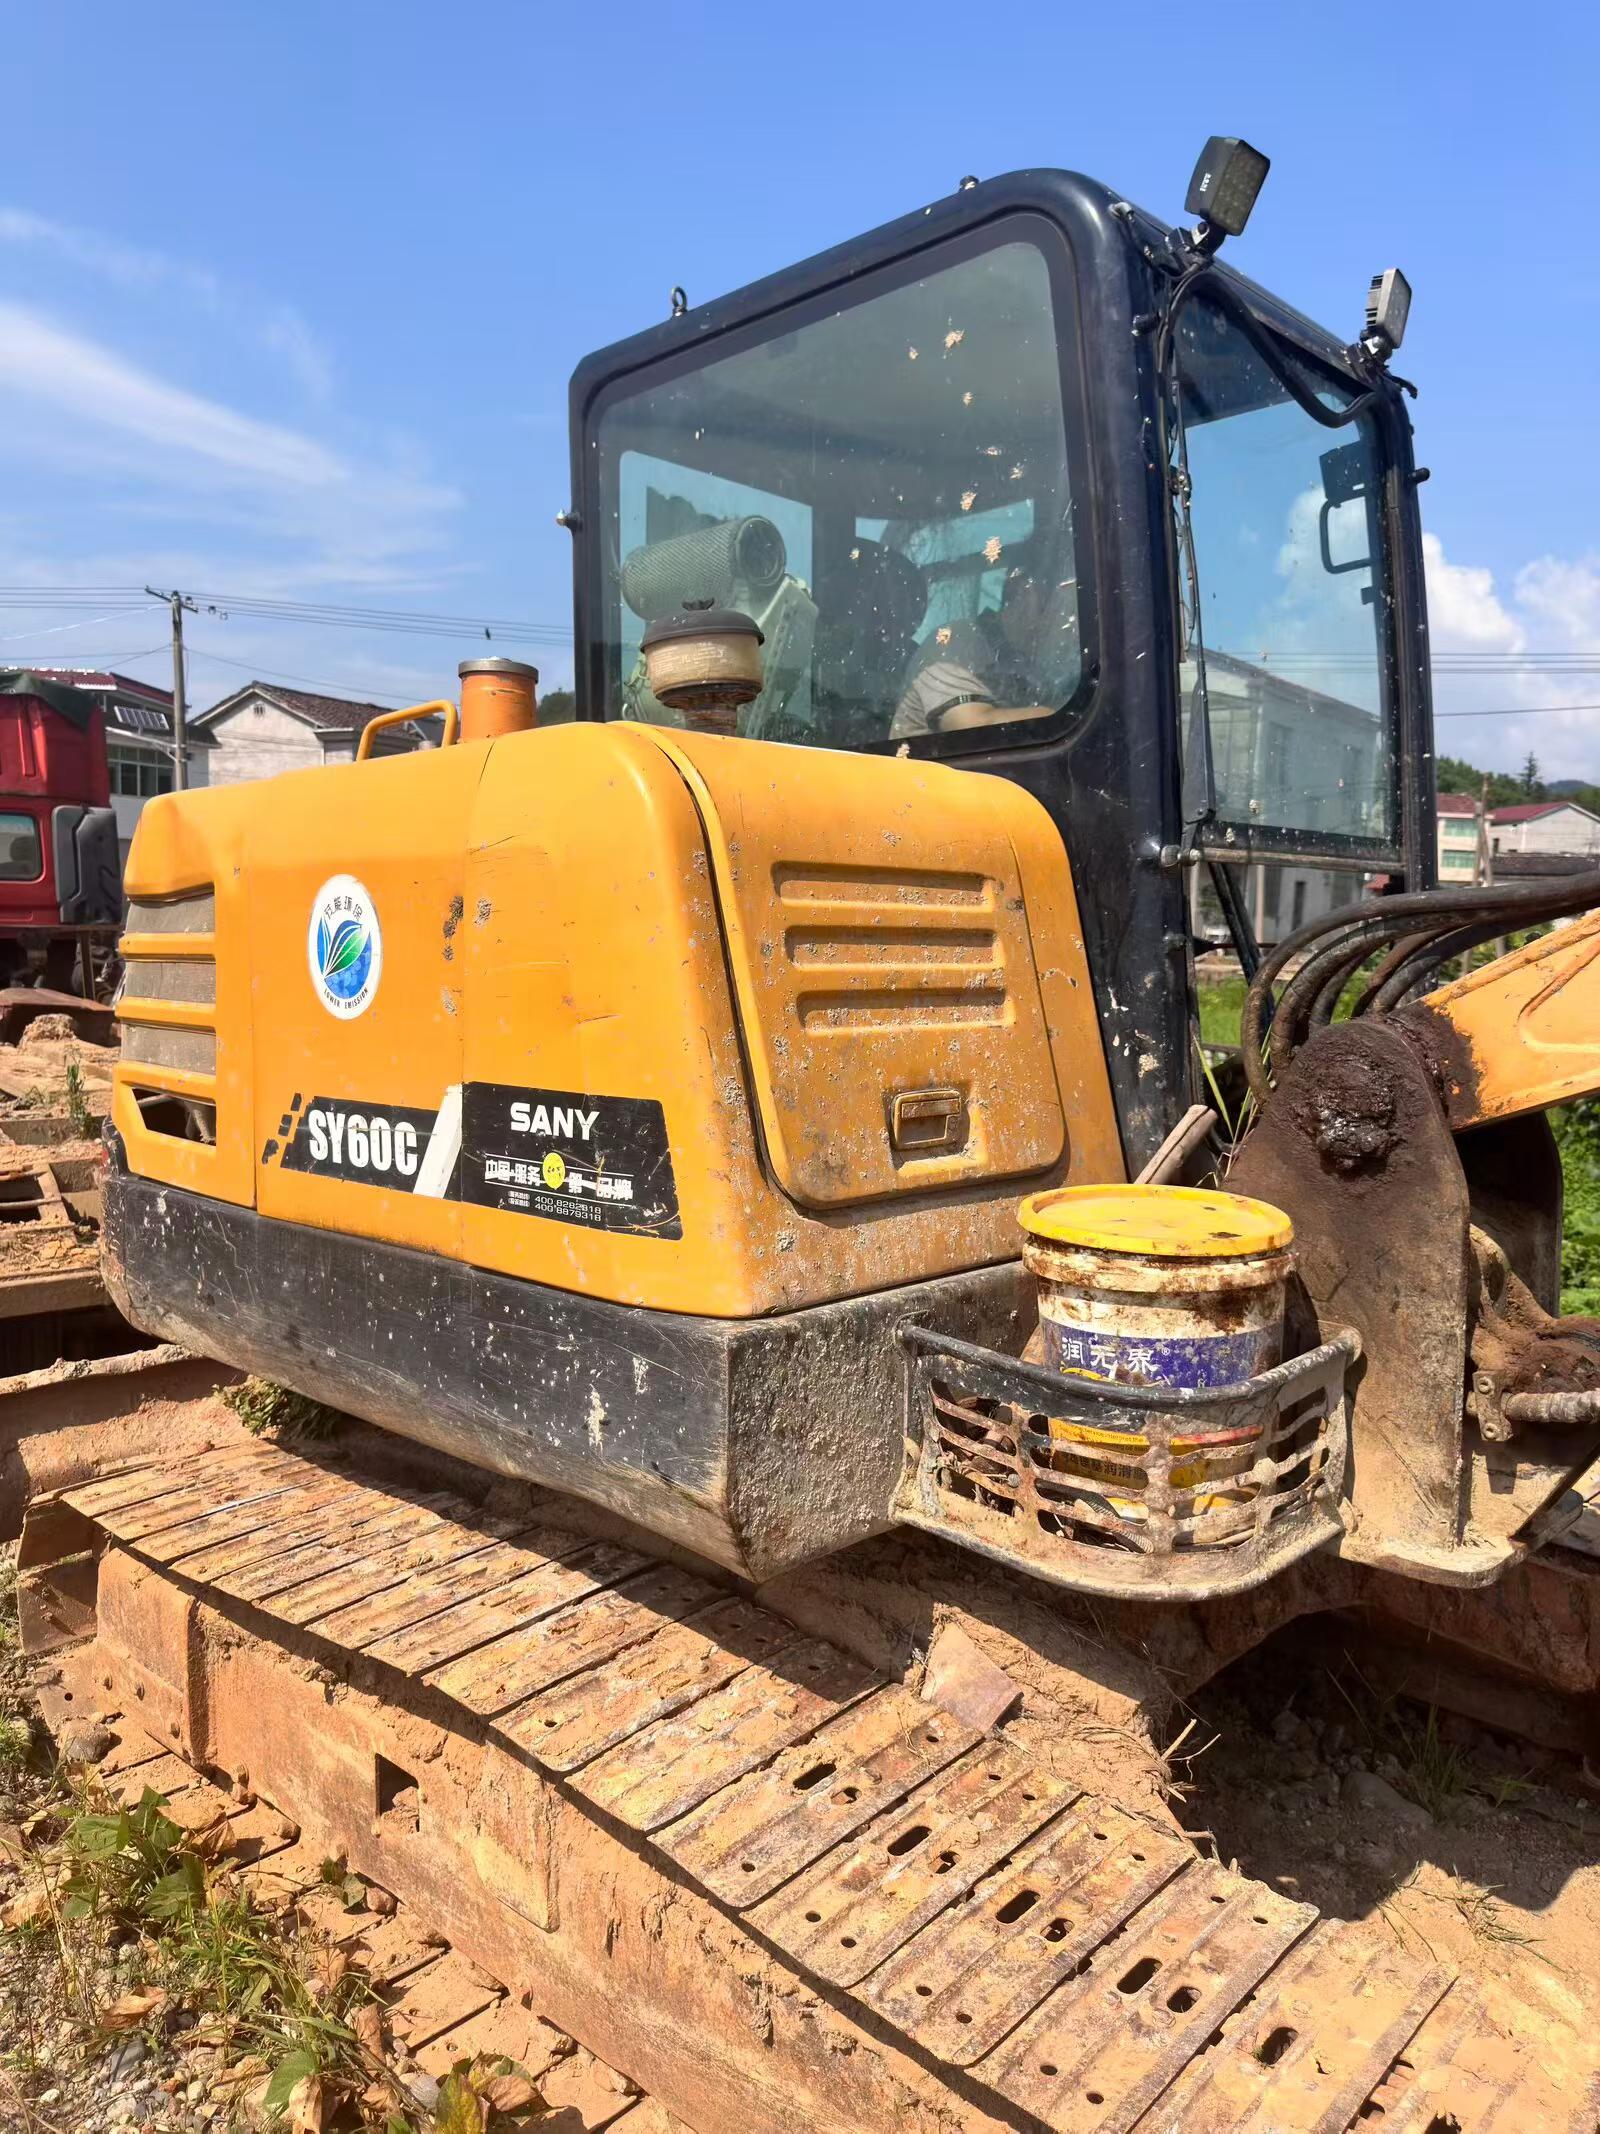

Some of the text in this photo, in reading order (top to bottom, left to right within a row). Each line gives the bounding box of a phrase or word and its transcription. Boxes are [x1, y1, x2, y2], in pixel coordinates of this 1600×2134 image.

[324, 987, 368, 1009] LOWER EMISSION
[510, 1102, 600, 1141] SANY
[308, 1109, 418, 1176] SY60C
